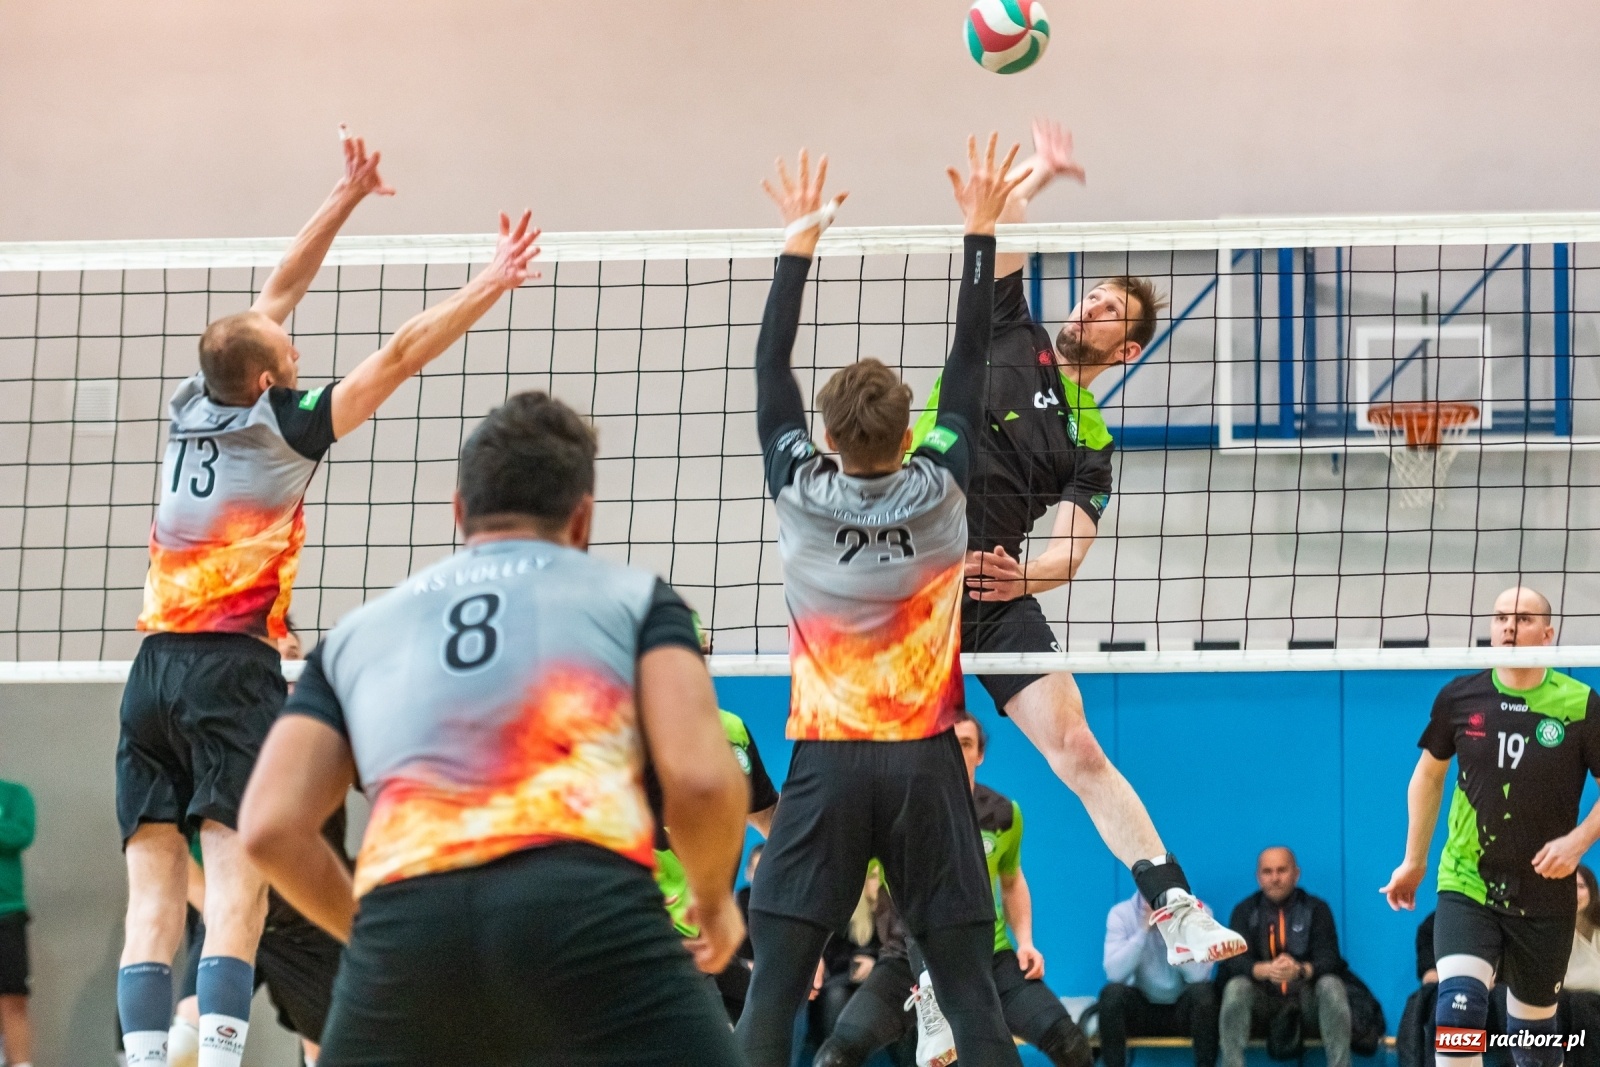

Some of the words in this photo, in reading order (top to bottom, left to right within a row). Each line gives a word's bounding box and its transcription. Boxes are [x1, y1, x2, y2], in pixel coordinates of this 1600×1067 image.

[170, 436, 220, 499] 13
[833, 524, 917, 567] 23
[443, 589, 503, 673] 8
[1497, 731, 1525, 769] 19
